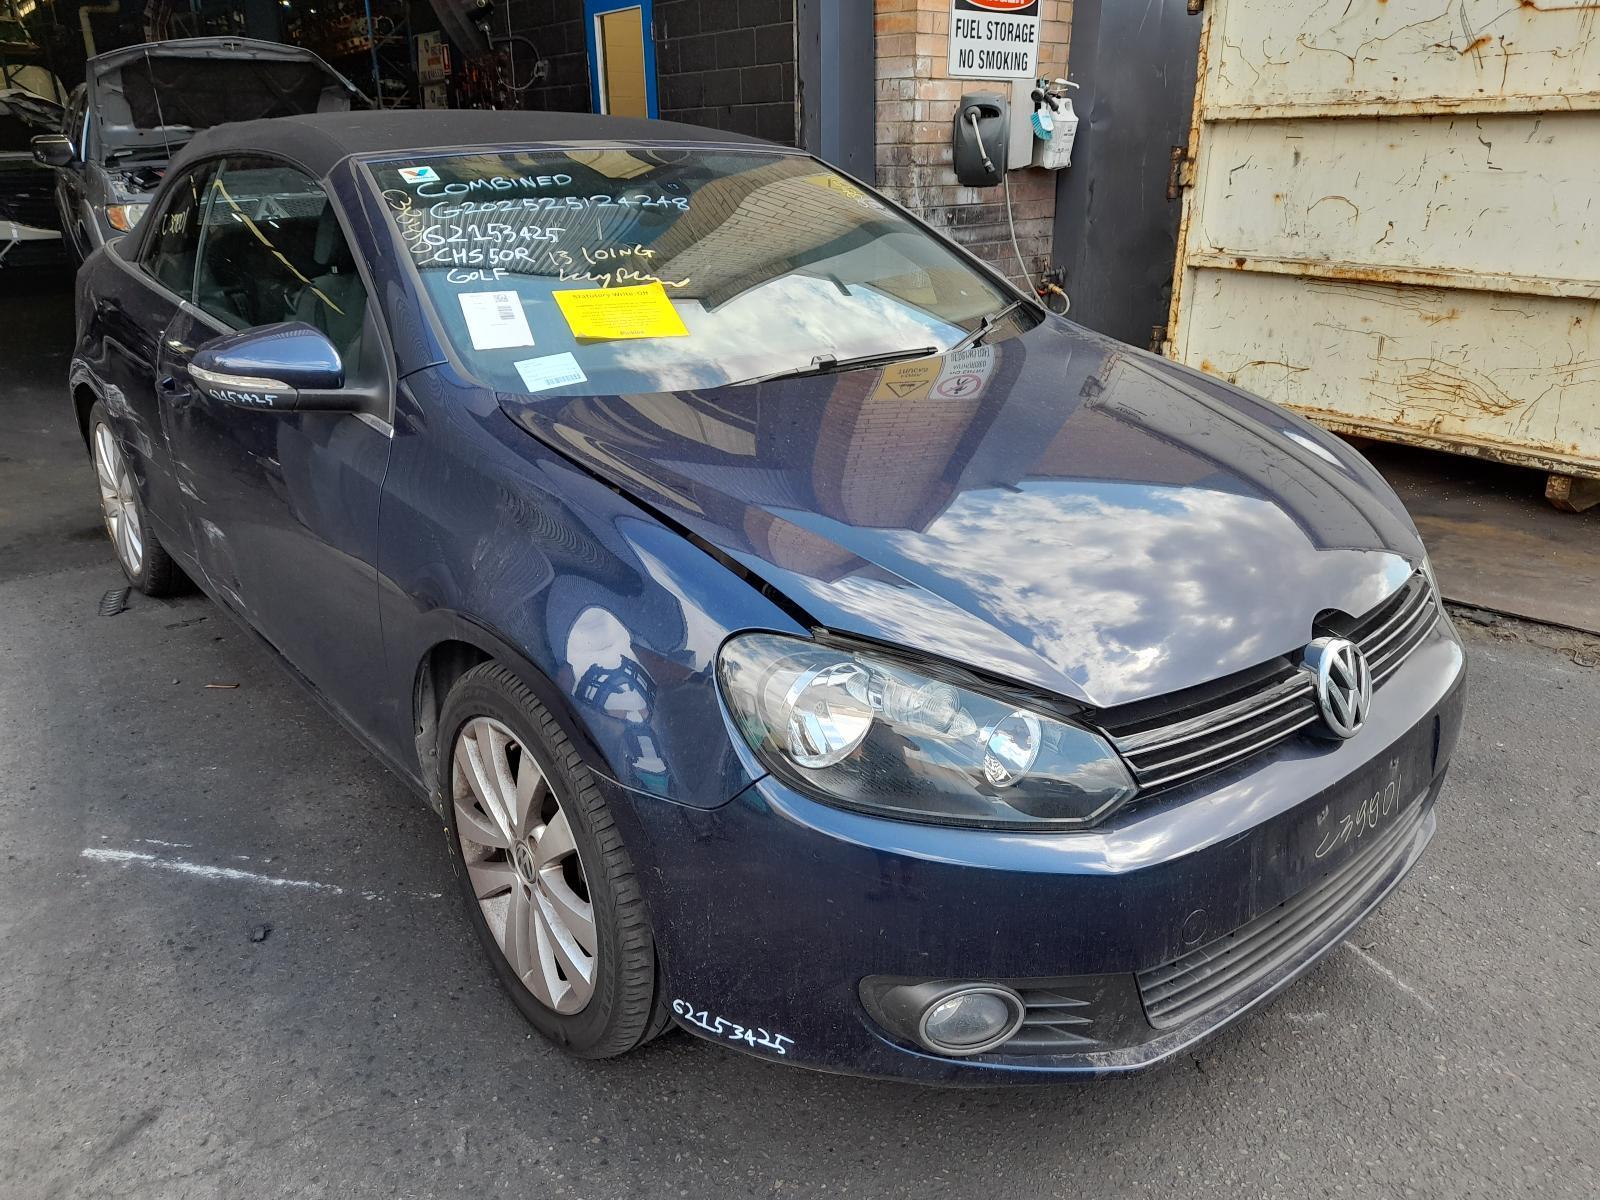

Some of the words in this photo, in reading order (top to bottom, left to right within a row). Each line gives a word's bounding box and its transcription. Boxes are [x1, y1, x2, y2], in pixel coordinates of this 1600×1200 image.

[956, 18, 982, 39] FUEL
[986, 20, 1035, 43] STORAGE
[958, 49, 975, 69] NO
[978, 50, 1028, 71] SMOKING
[417, 173, 572, 198] COMBINED
[446, 267, 510, 284] GOLF
[672, 998, 795, 1055] 62153425
